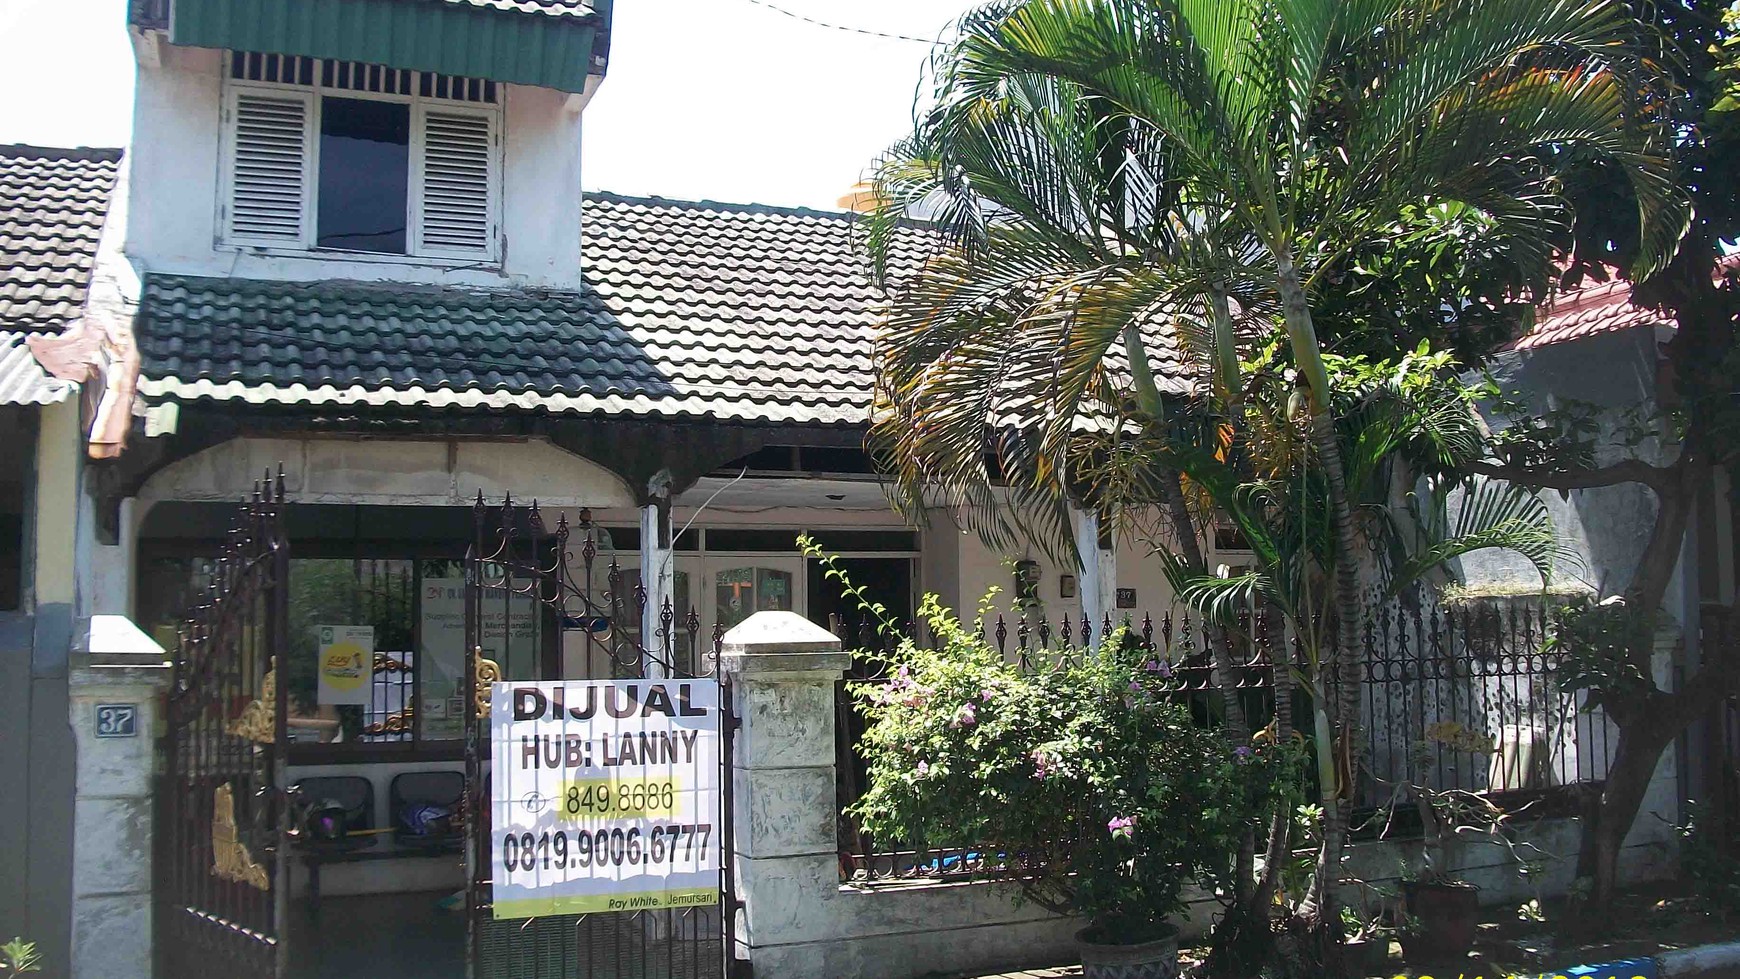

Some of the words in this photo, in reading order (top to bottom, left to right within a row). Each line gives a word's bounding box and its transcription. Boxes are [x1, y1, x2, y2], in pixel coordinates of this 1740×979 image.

[513, 683, 708, 721] DIJUAL
[100, 709, 133, 733] 37
[521, 732, 592, 769] HUB:
[602, 729, 699, 767] LANNY
[566, 782, 674, 814] 849.8686
[503, 824, 712, 873] 0819.9006.6777
[608, 898, 628, 910] Ray
